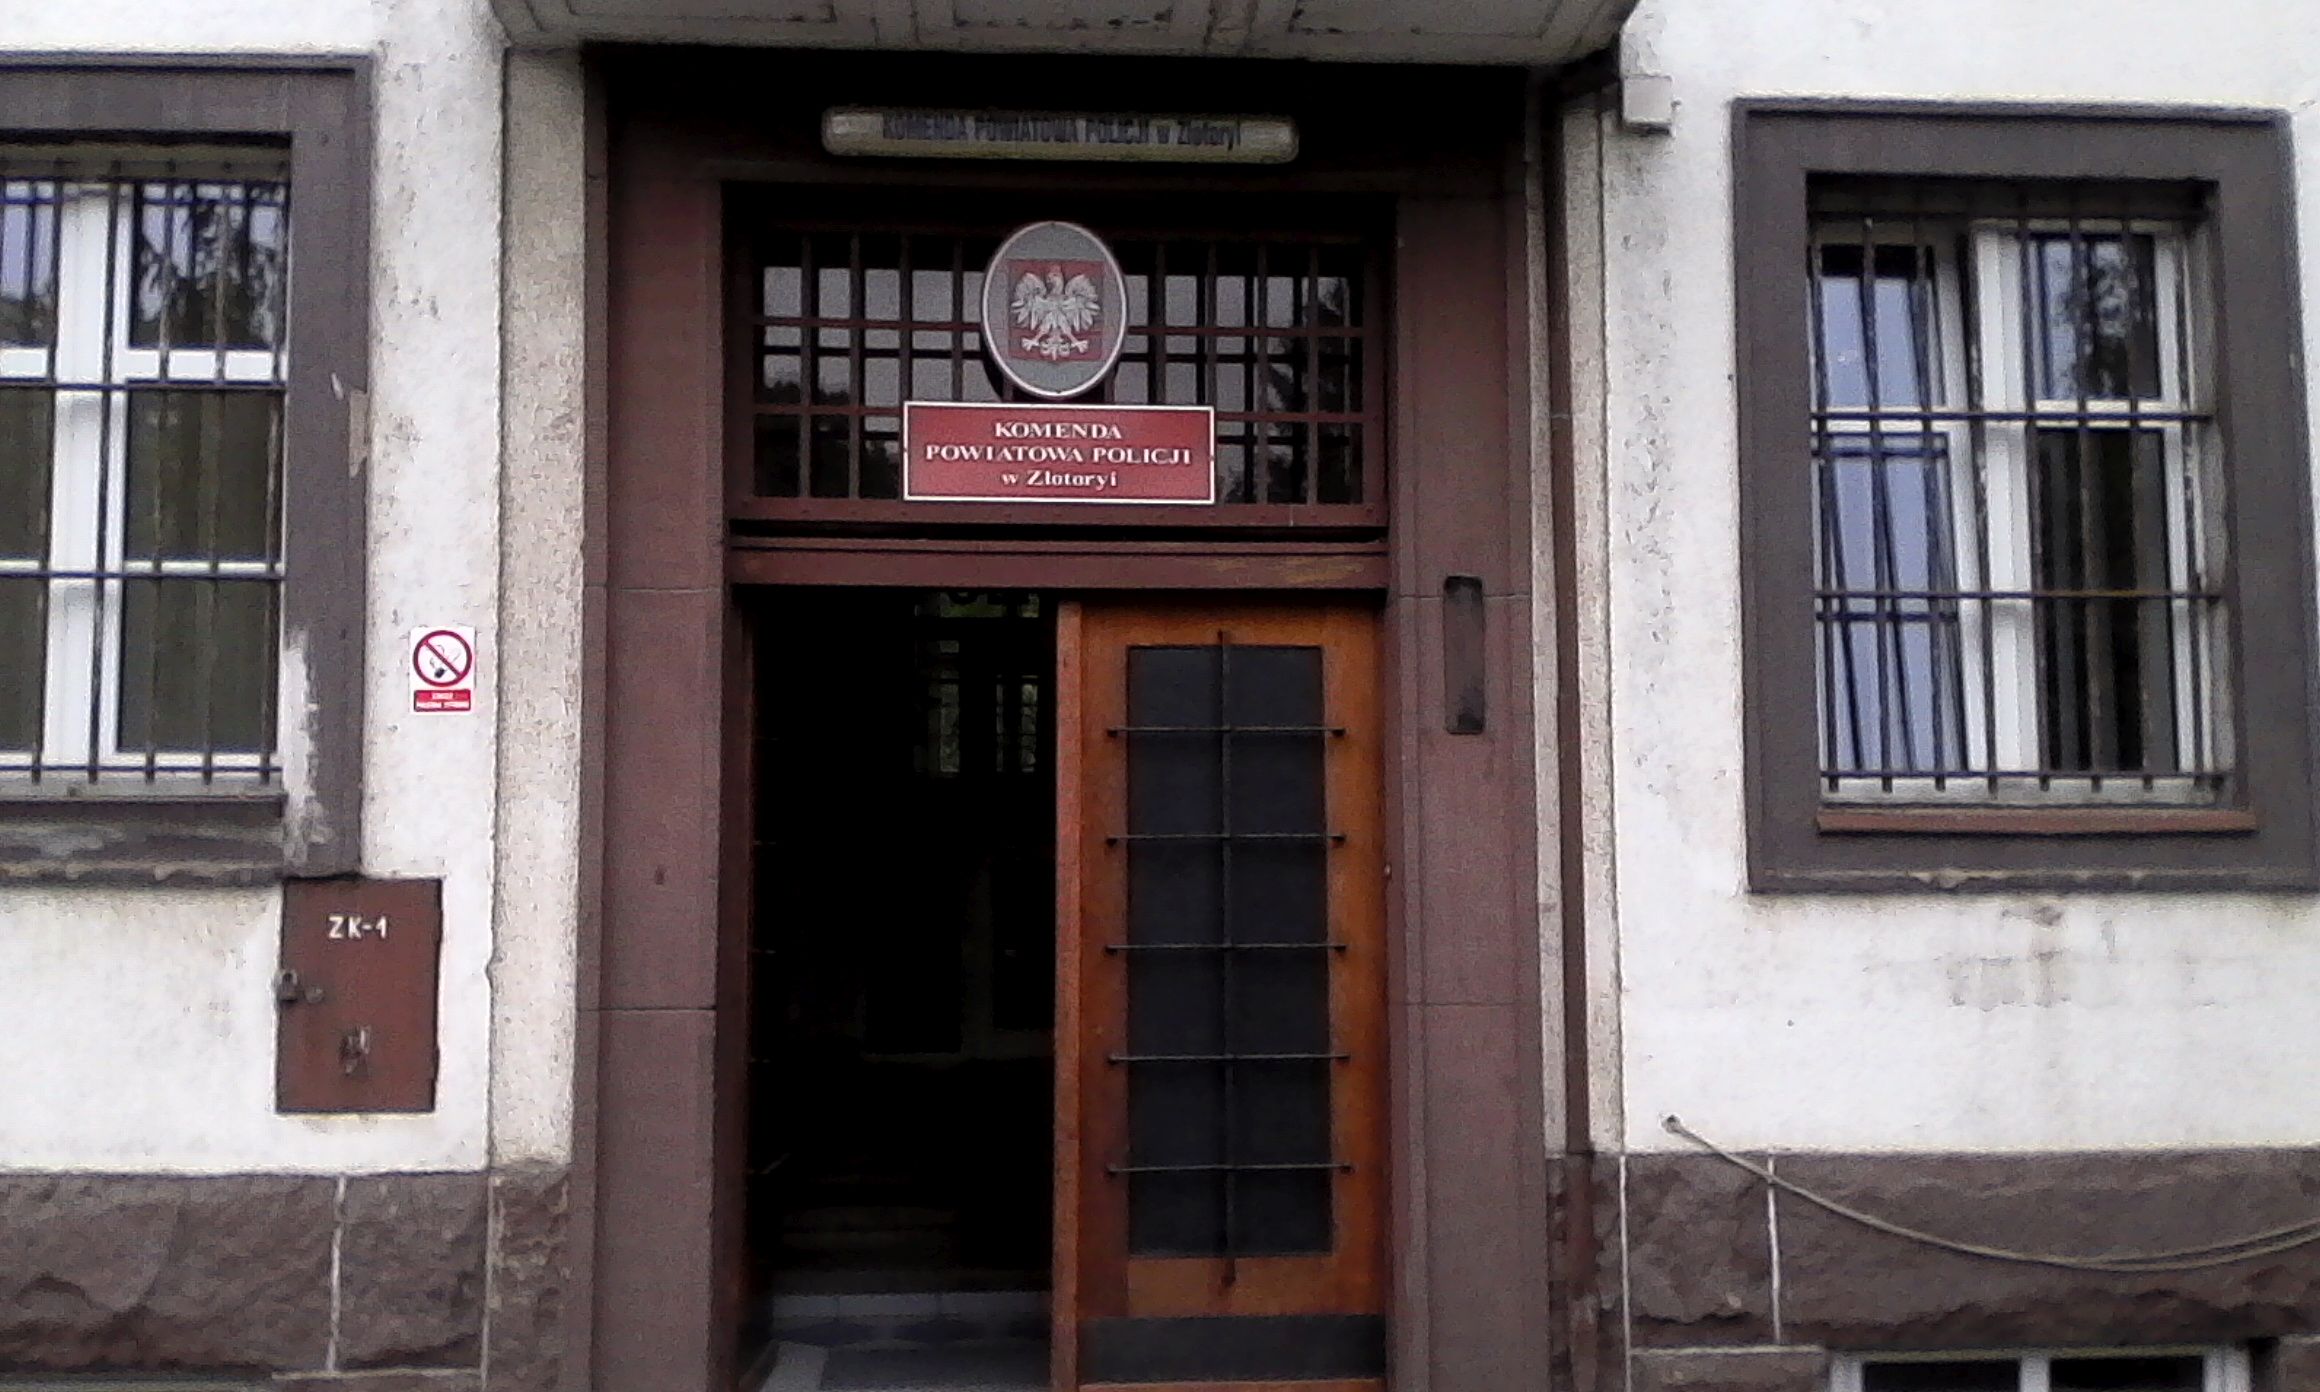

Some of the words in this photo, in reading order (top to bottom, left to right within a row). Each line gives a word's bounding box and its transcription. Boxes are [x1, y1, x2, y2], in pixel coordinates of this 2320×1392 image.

[995, 422, 1122, 439] KOMENDA
[925, 444, 1083, 462] POWIATOWA
[1092, 447, 1191, 464] POLICJI
[1002, 473, 1018, 485] w
[328, 914, 388, 939] ZK-1
